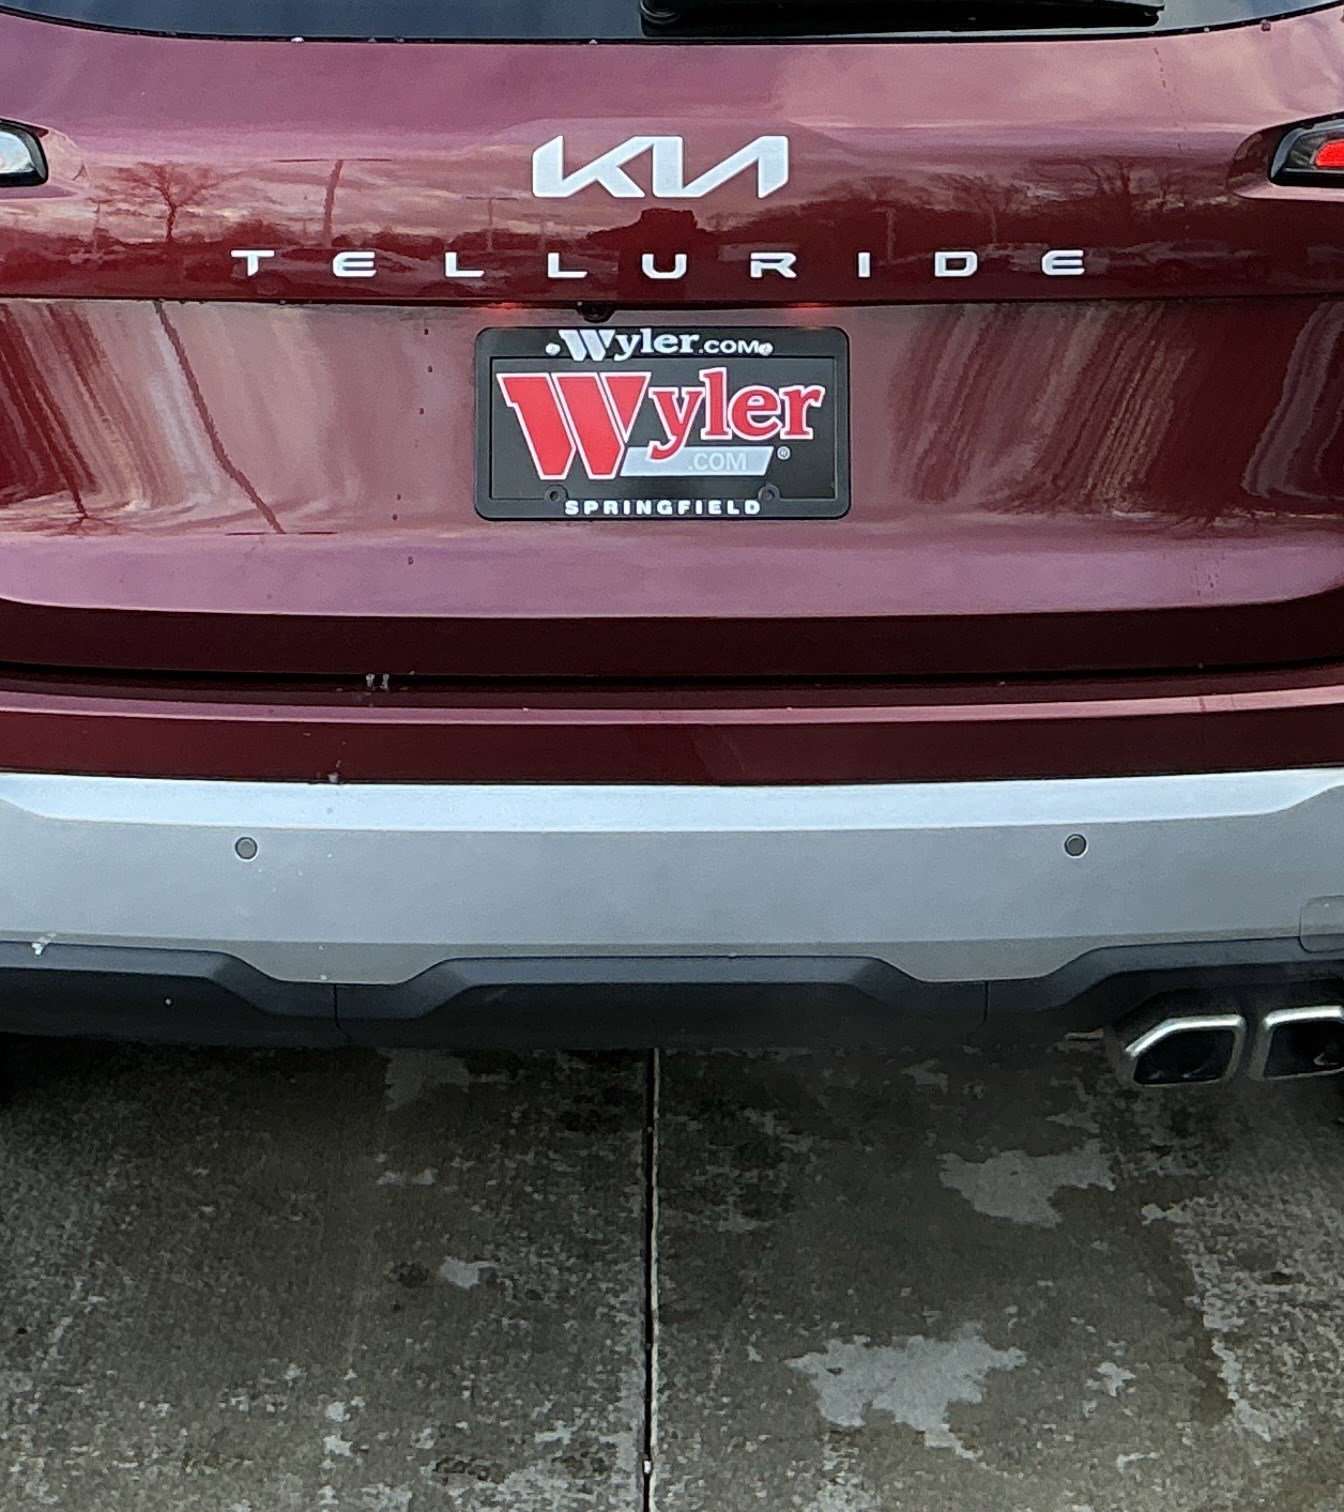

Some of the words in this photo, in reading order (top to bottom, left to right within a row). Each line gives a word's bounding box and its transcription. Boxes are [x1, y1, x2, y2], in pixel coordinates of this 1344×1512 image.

[532, 134, 789, 199] KIA
[231, 249, 1086, 279] TELLURIDE
[496, 367, 826, 480] Wyler
[564, 499, 761, 515] SPRINGFIELD
